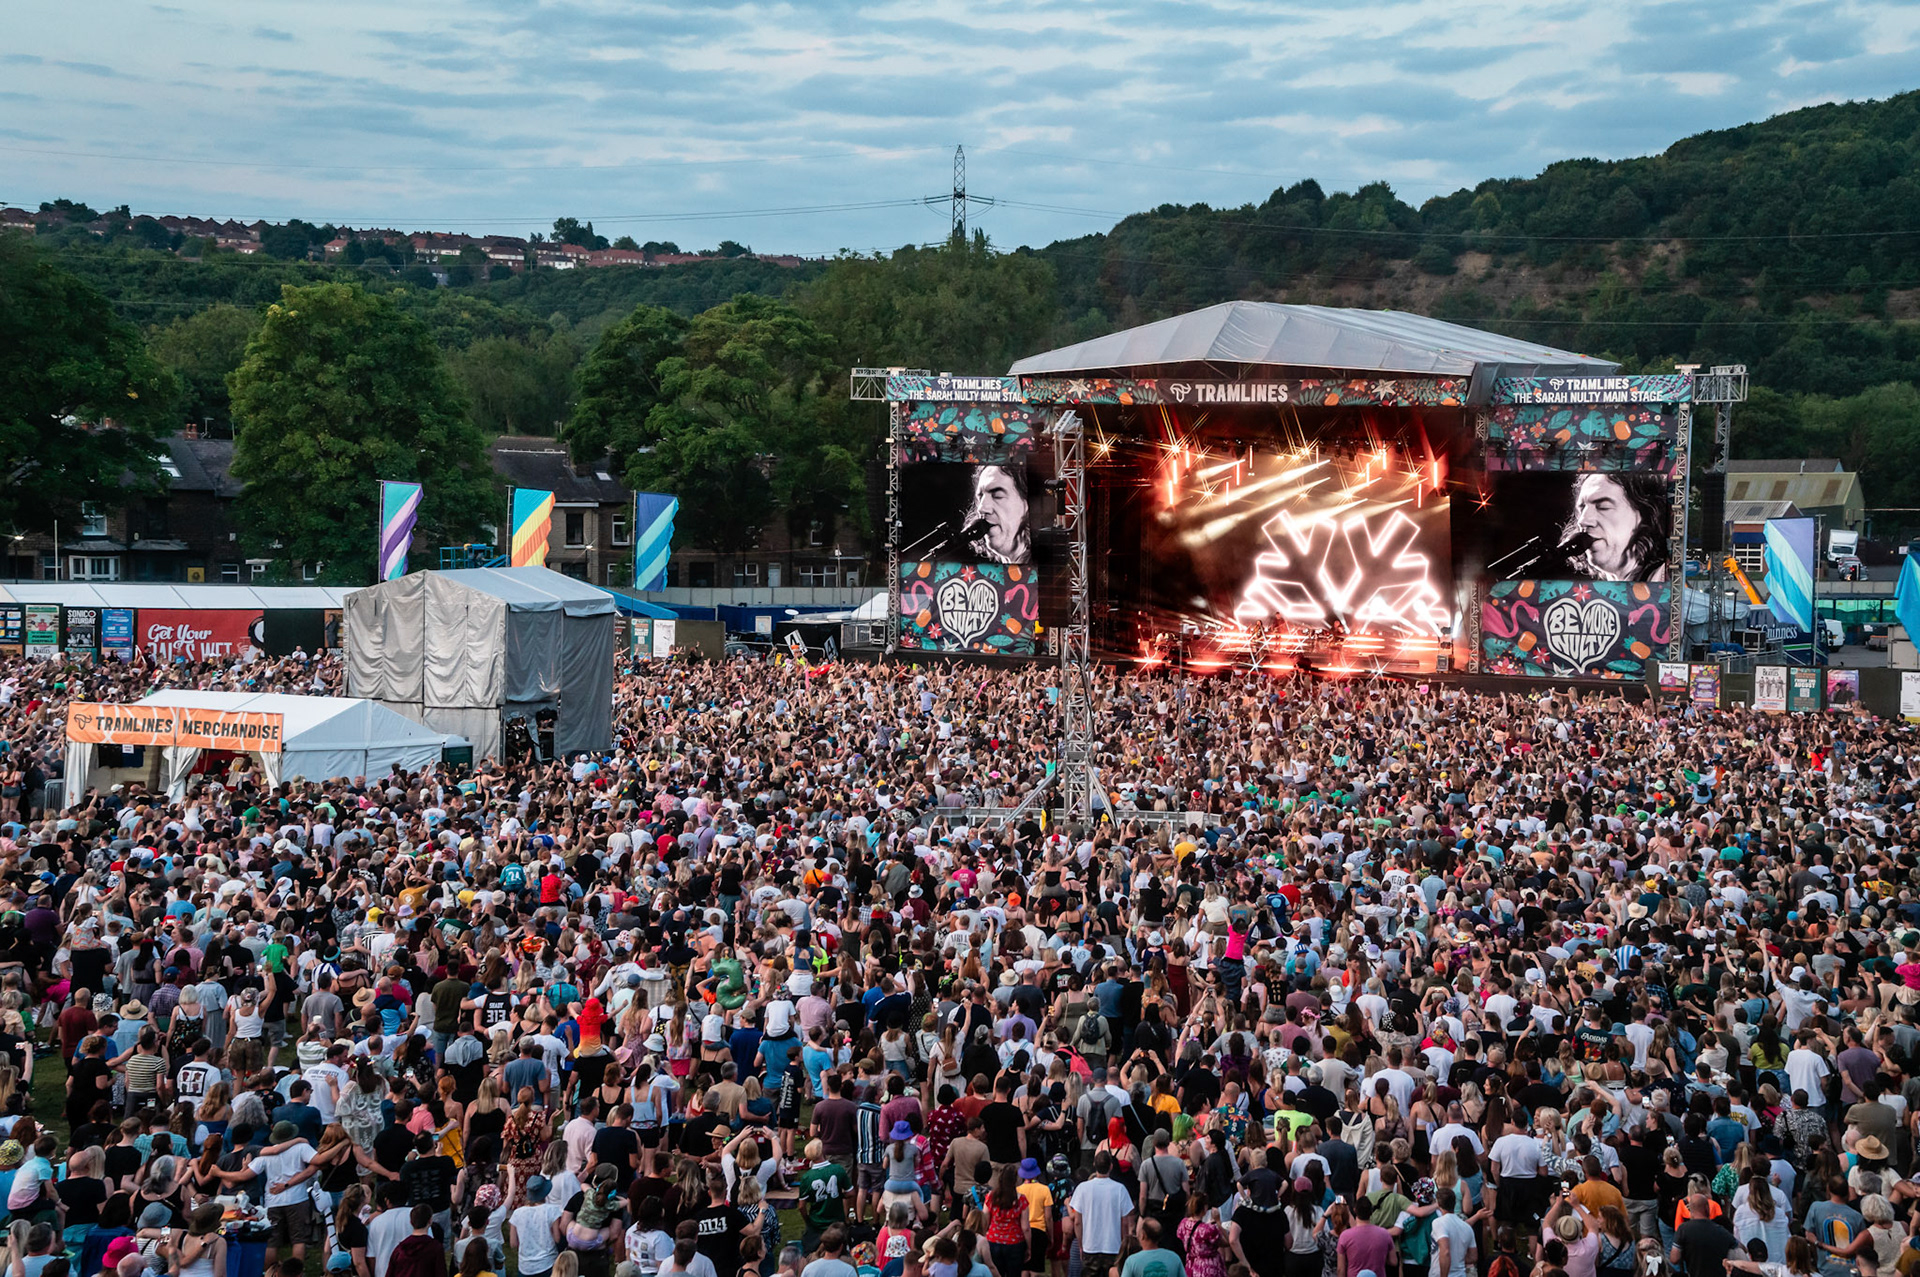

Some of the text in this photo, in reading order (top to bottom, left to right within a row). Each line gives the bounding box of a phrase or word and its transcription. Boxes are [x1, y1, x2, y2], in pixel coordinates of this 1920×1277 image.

[951, 379, 1001, 390] TRAMLINES
[1195, 384, 1288, 402] TRAMLINES
[1567, 378, 1630, 390] TRAMLINES
[909, 390, 924, 400] THE
[927, 391, 953, 400] SARAH
[955, 391, 979, 401] NULTY
[981, 391, 1001, 401] MAIN
[1513, 390, 1663, 404] THE SARAH NULTY MAIN STAGE
[942, 584, 995, 613] BE MORE
[67, 617, 96, 625] SATURDAY
[943, 611, 991, 638] NULTY
[1549, 604, 1616, 636] BE MORE
[147, 623, 175, 643] Get
[175, 624, 212, 650] Your
[1551, 634, 1611, 663] NULTY
[95, 716, 279, 740] TRAMLINES MERCHANDISE
[486, 1009, 507, 1023] 313
[811, 1174, 839, 1202] 24
